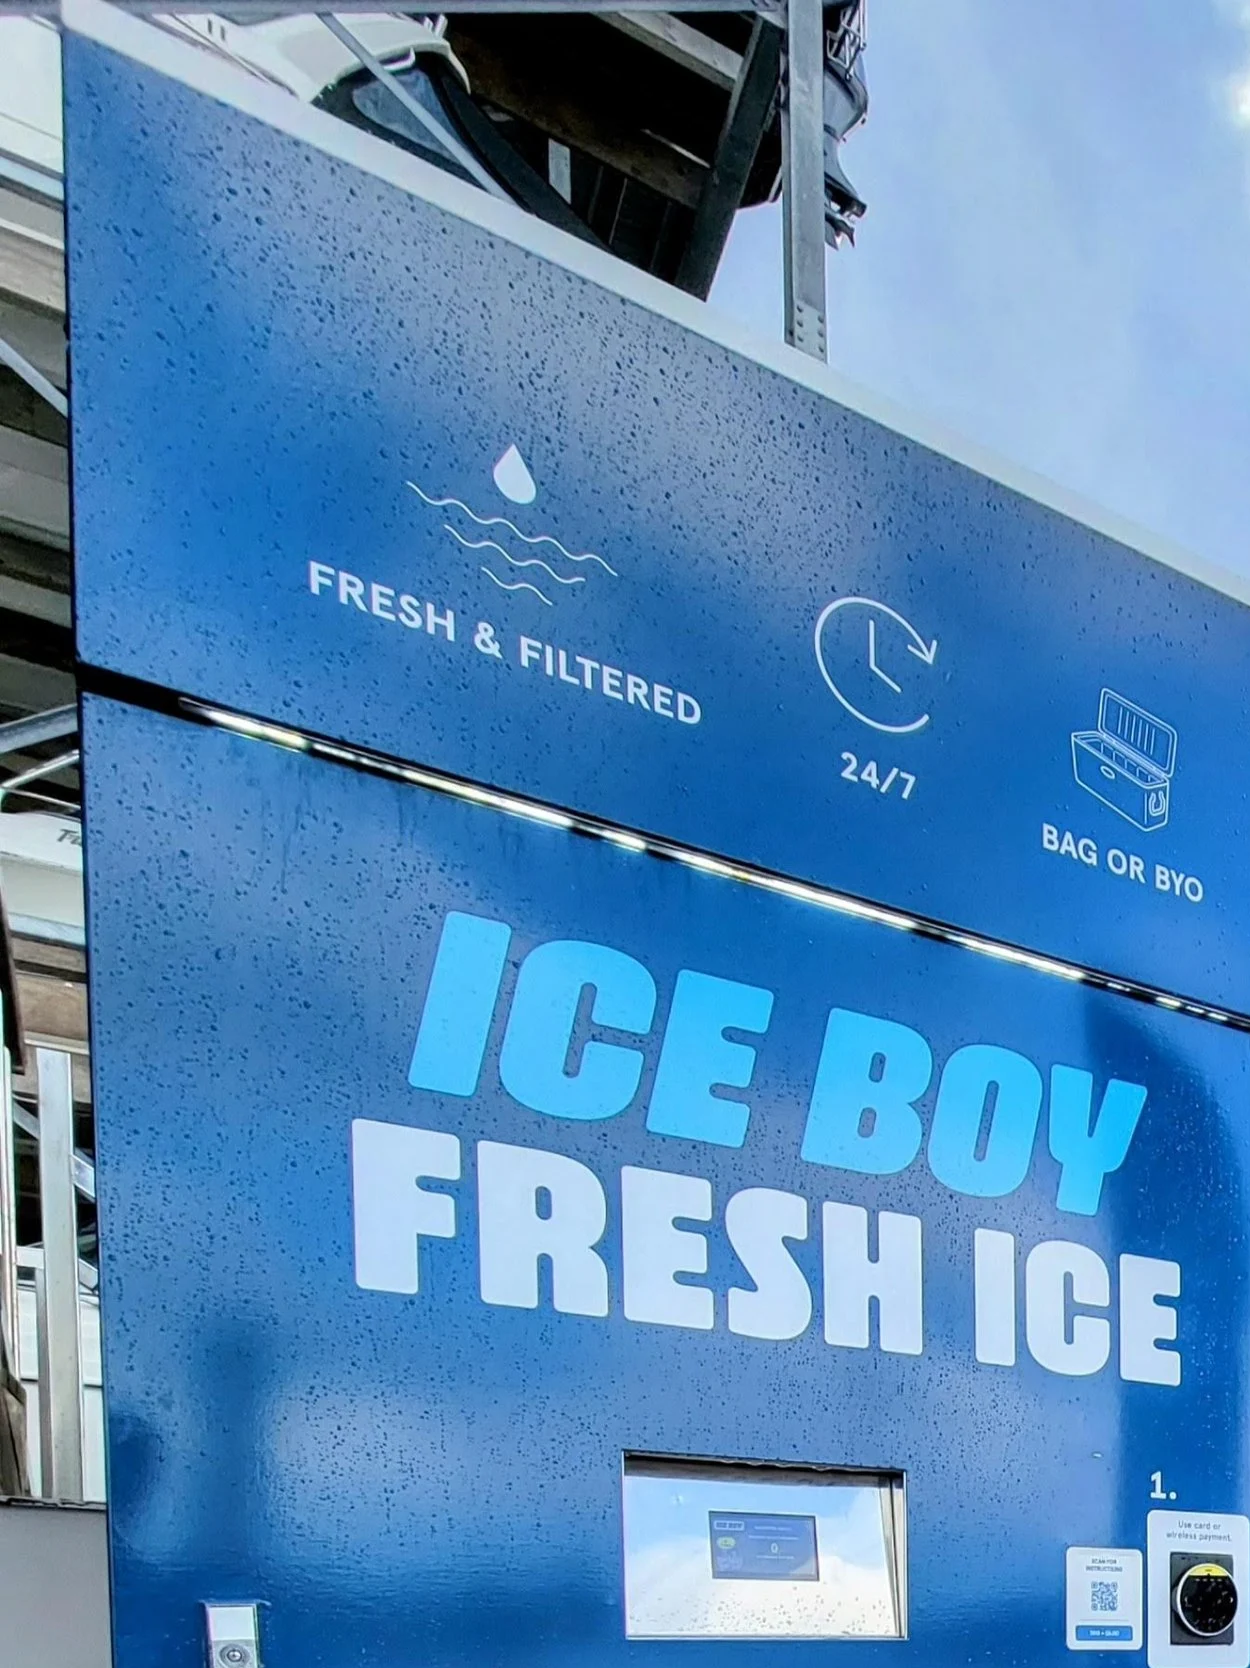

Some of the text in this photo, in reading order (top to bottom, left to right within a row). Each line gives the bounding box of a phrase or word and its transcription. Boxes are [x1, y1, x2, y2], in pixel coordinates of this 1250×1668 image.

[309, 560, 701, 725] FRESH & FILTERED
[840, 751, 916, 800] 24/7
[1042, 822, 1203, 902] BAG OR BYO
[407, 910, 1148, 1217] ICE BOY
[351, 1118, 1182, 1386] FRESH ICE
[1149, 1471, 1178, 1501] 1.
[1166, 1530, 1197, 1541] wireless
[1178, 1519, 1192, 1529] Use
[1194, 1520, 1210, 1531] card
